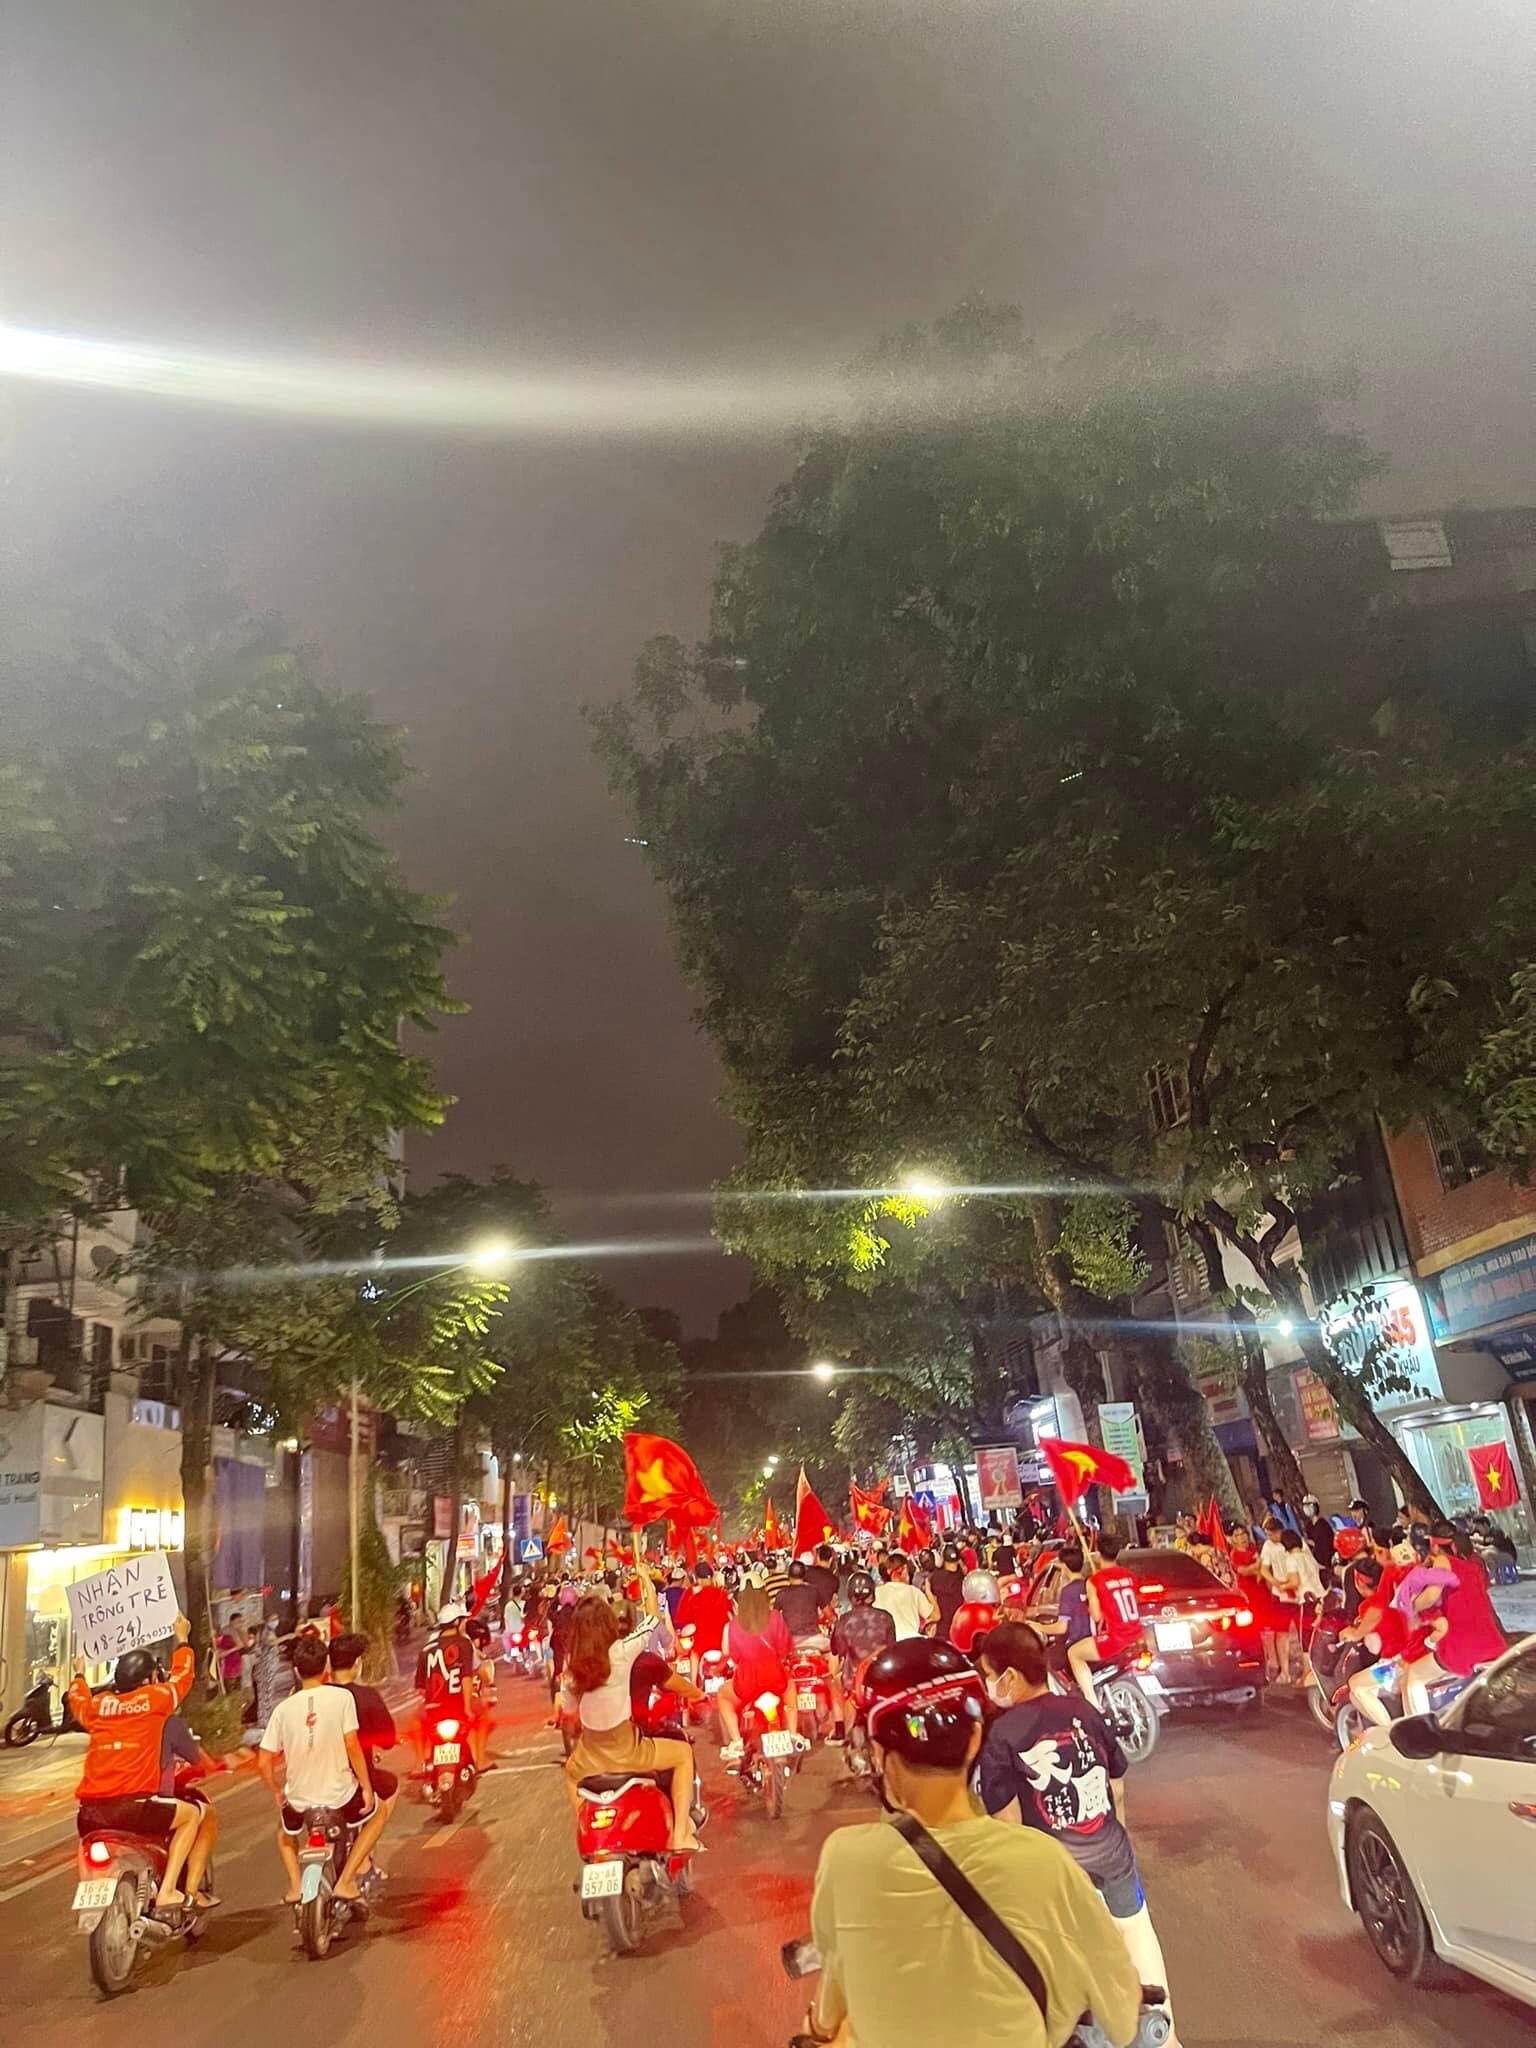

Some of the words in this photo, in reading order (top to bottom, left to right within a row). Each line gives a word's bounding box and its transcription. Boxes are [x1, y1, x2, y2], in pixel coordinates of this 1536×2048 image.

[77, 1561, 140, 1608] NHẬN
[82, 1602, 125, 1630] TRÔNG
[128, 1575, 168, 1608] TRẺ
[1112, 1587, 1140, 1624] 10
